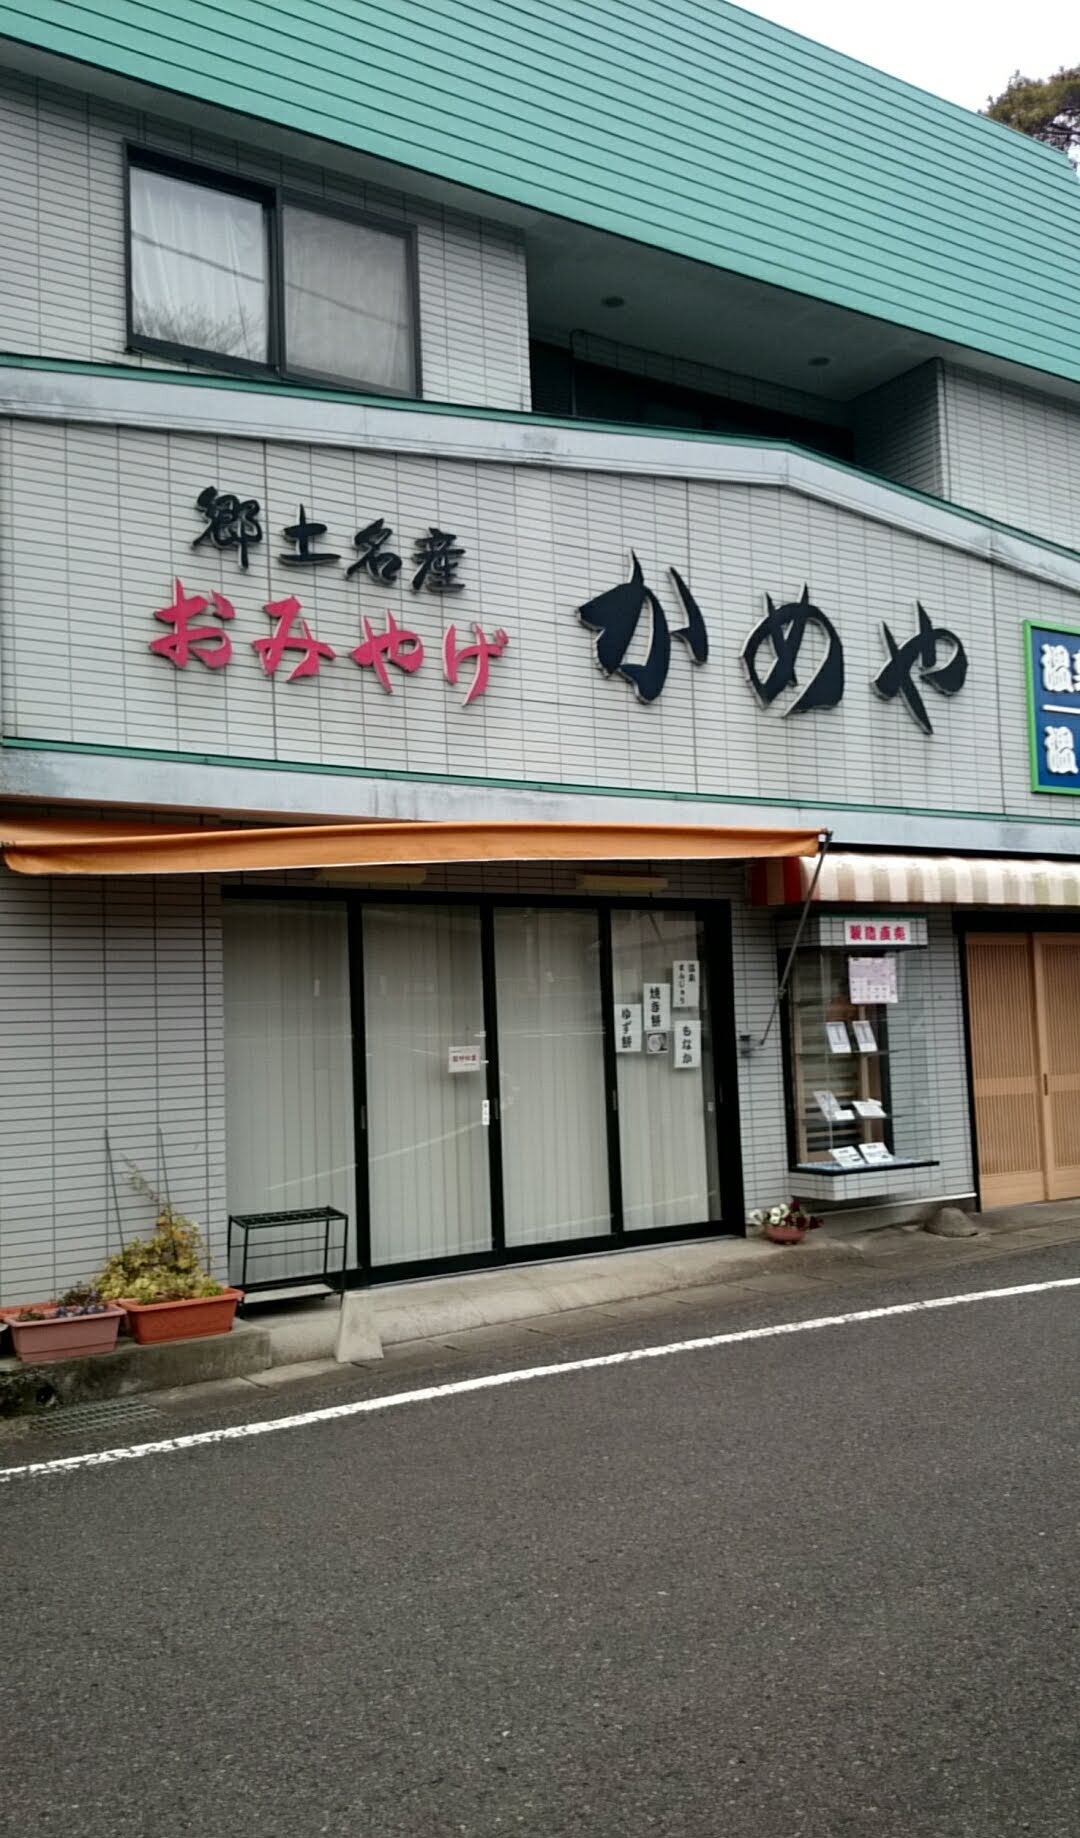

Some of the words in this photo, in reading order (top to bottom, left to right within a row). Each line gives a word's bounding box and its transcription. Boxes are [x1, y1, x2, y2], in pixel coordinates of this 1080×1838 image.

[191, 486, 466, 593] 郷土名産
[149, 576, 509, 706] おみやげ
[576, 547, 968, 735] かめや
